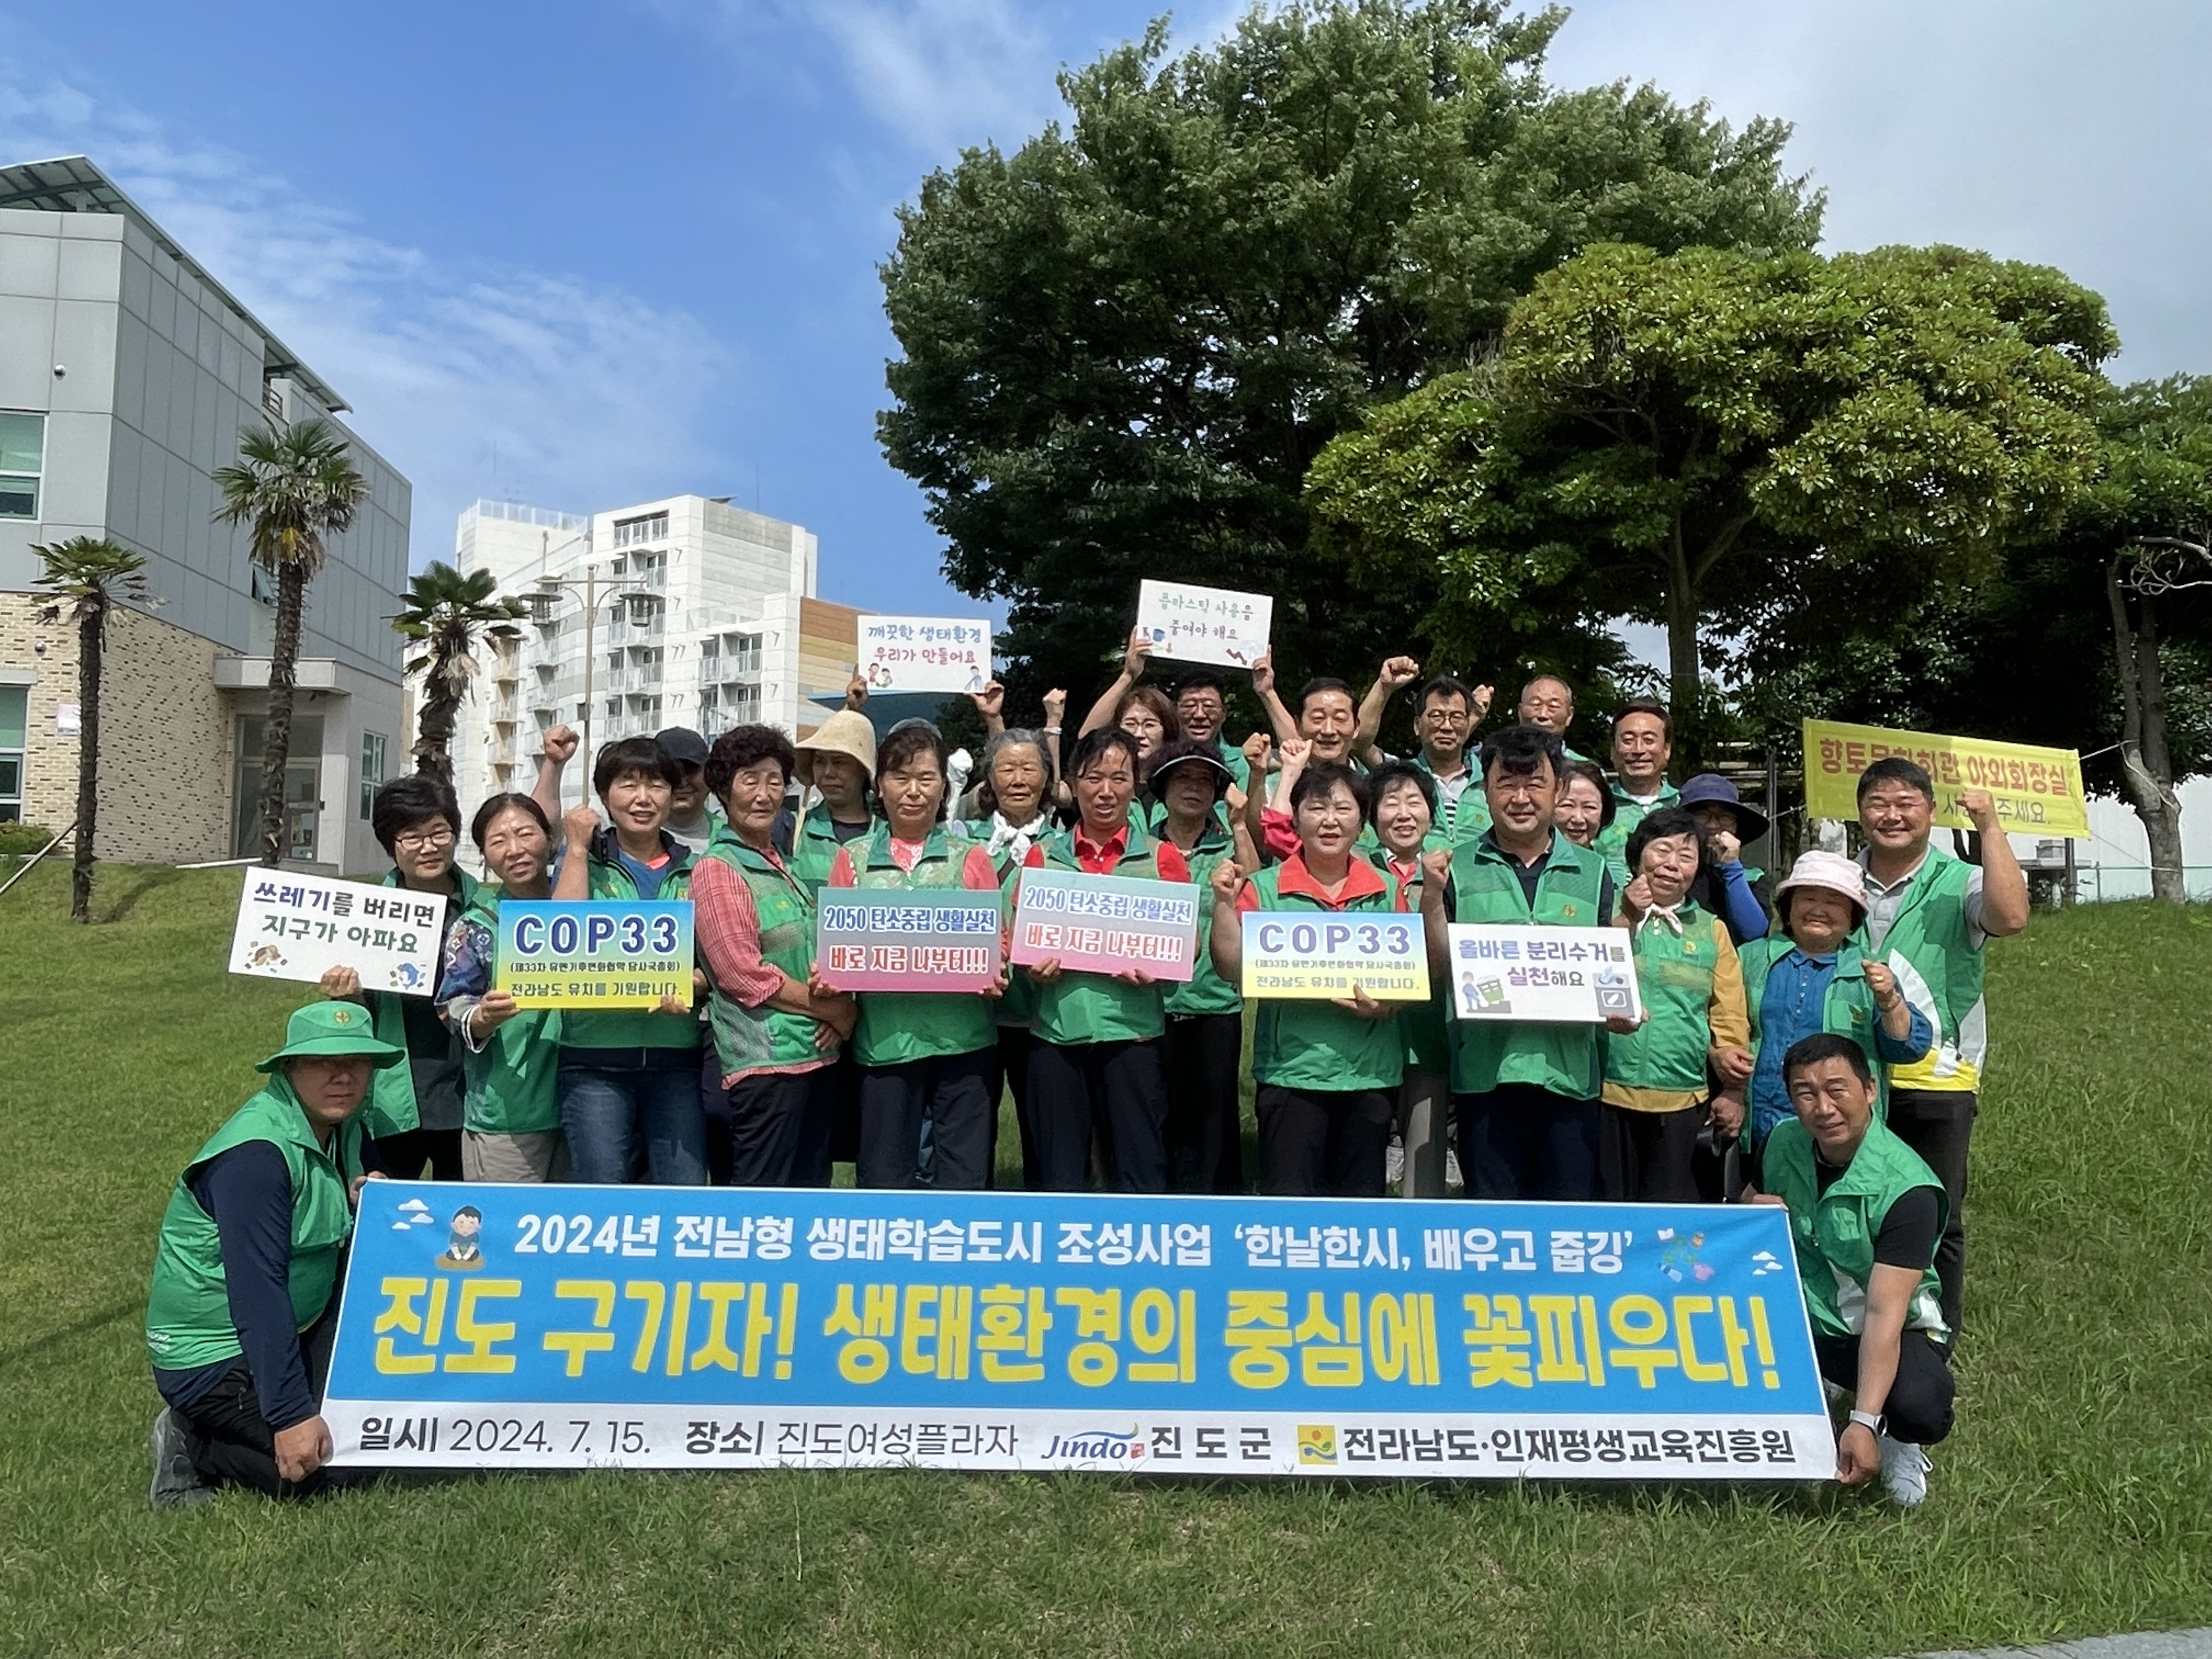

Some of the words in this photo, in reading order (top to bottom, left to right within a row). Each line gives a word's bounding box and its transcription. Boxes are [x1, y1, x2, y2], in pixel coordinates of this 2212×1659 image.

[1159, 592, 1209, 613] 플라스틱
[1215, 600, 1254, 620] 사용을
[867, 624, 915, 641] 깨끗한
[920, 625, 981, 644] 생태환경
[1213, 624, 1238, 640] 해요
[874, 646, 917, 662] 우리가
[922, 647, 977, 665] 만들어요
[253, 882, 353, 917] 쓰레기를
[364, 896, 435, 928] 버리면
[1025, 887, 1066, 911] 2050
[1069, 890, 1130, 918] 탄소중립
[1132, 896, 1193, 926] 생활실천
[826, 906, 867, 930] 2050
[870, 907, 932, 932] 탄소중립
[935, 909, 996, 933] 생활실천
[262, 914, 337, 943] 지구가
[347, 926, 417, 953] 아파요
[515, 916, 678, 955] COP33
[1025, 922, 1062, 949] 바로
[1065, 926, 1103, 954] 지금
[1106, 931, 1182, 962] 나부터!!!
[1259, 924, 1410, 955] COP33
[830, 946, 866, 971] 바로
[871, 946, 907, 972] 지금
[912, 947, 988, 973] 나부터!!!
[1459, 940, 1520, 960] 올바른
[1526, 941, 1626, 962] 분리수거를
[511, 983, 563, 996] 전라남도
[568, 983, 606, 996] 유치를
[612, 982, 682, 996] 기원합니다.
[1256, 976, 1306, 988] 전라남도
[1311, 977, 1347, 988] 유치를
[1508, 967, 1585, 986] 실천해요
[514, 1214, 661, 1257] 2024년
[673, 1215, 793, 1260] 전남형
[806, 1217, 1042, 1263] 생태학습도시
[1057, 1222, 1211, 1267] 조성사업
[1424, 1227, 1536, 1271] 배우고
[374, 1278, 522, 1374] 진도
[543, 1280, 798, 1380] 구기자!
[824, 1284, 1196, 1387] 생태환경의
[1224, 1290, 1441, 1389] 중심에
[1463, 1294, 1781, 1389] 꽃피우다!
[450, 1419, 552, 1453] 2024.
[569, 1421, 591, 1453] 7.
[609, 1421, 650, 1454] 15.
[777, 1422, 1018, 1457] 진도여성플라자
[1041, 1435, 1127, 1459] Jindo
